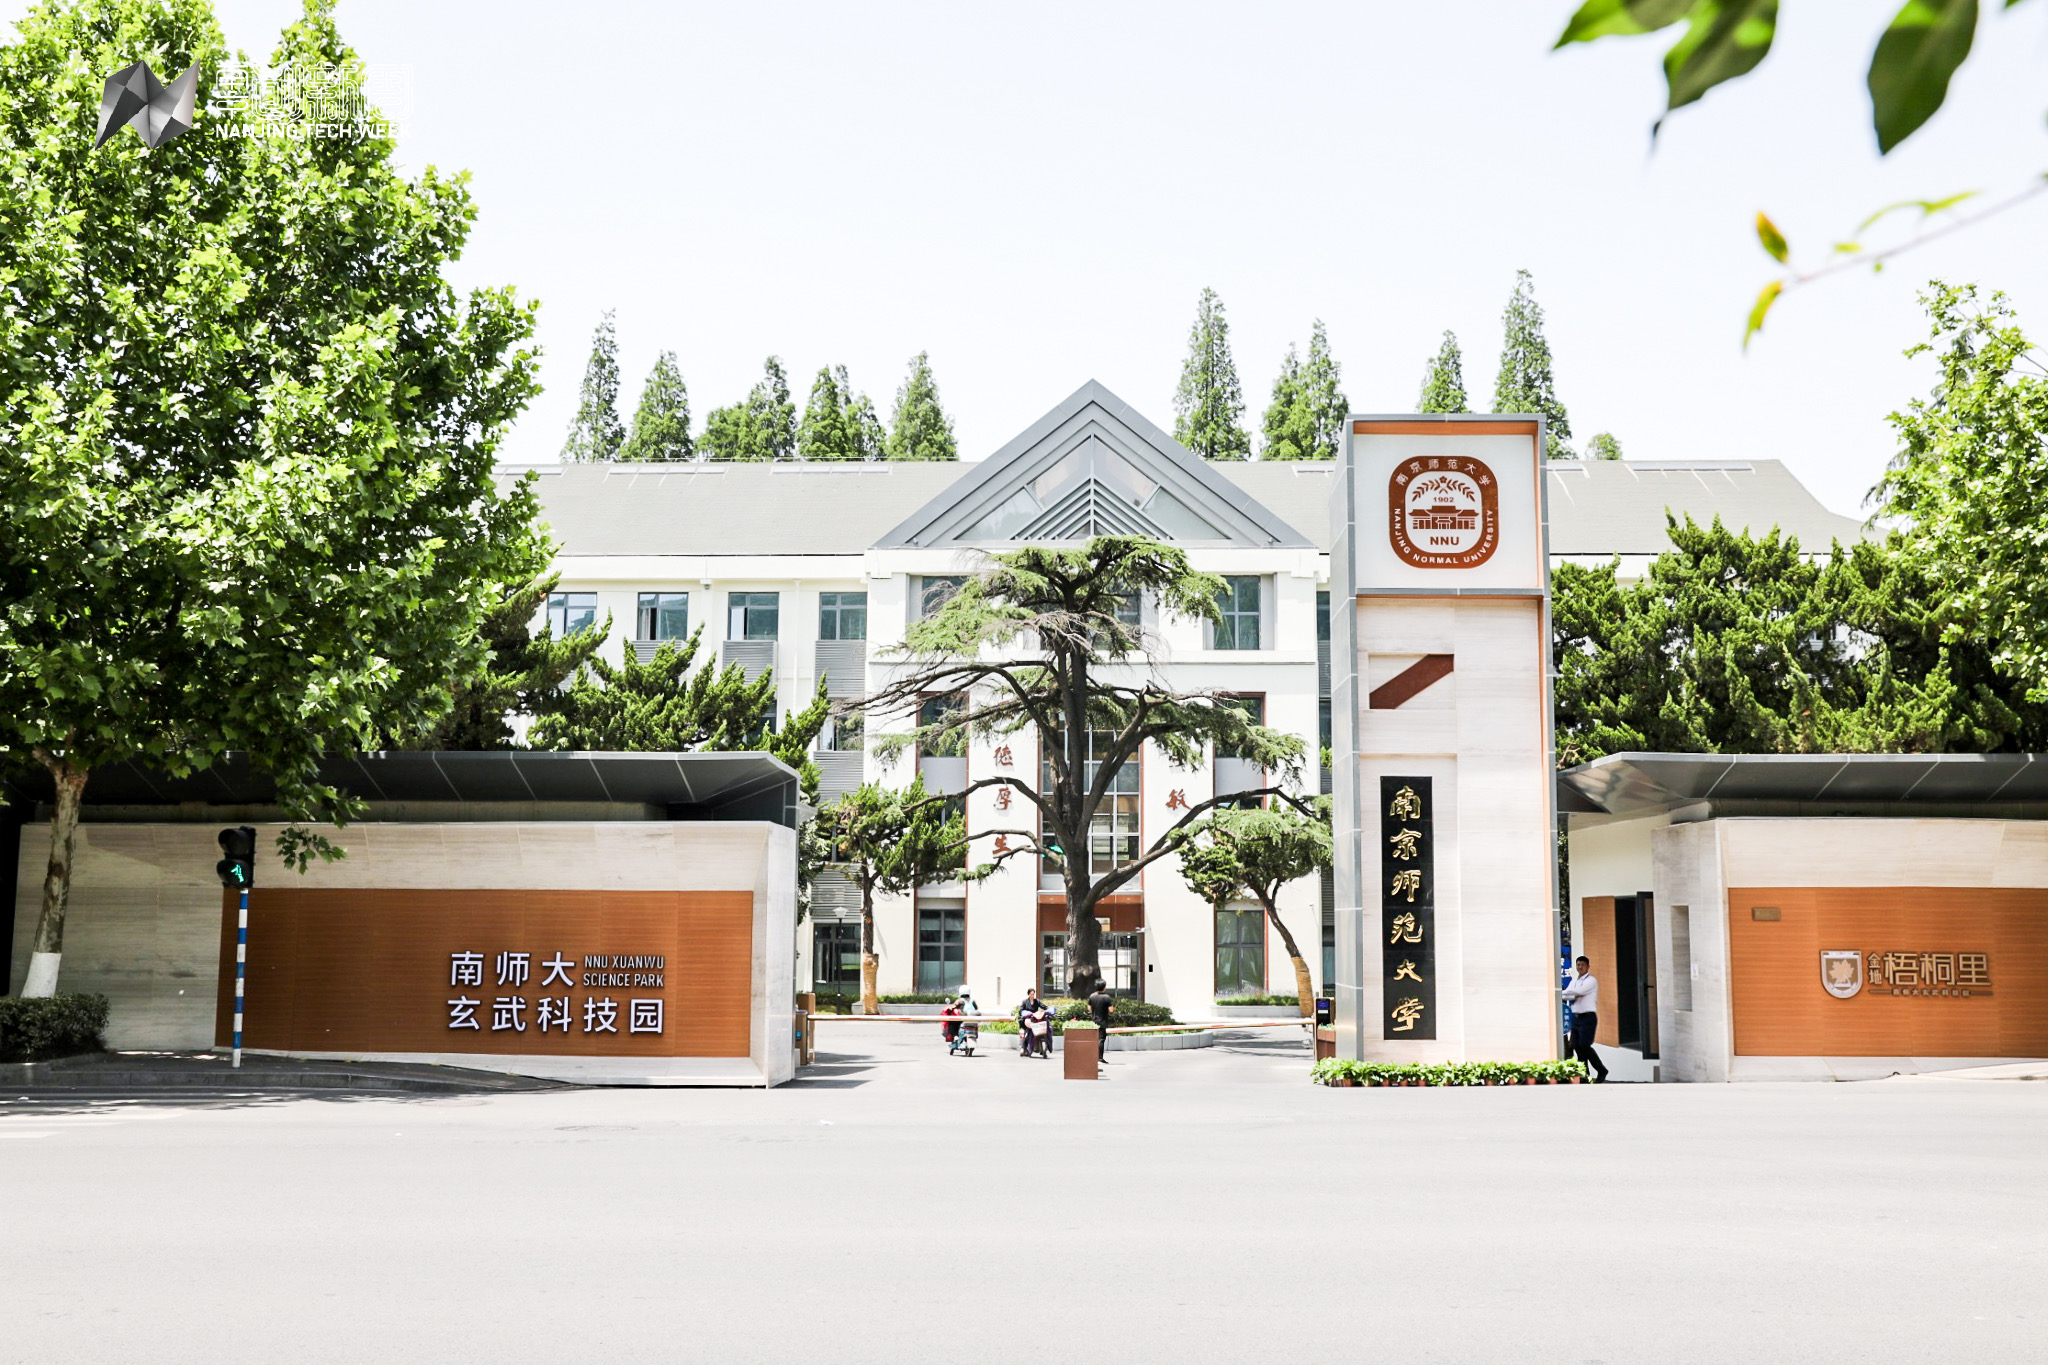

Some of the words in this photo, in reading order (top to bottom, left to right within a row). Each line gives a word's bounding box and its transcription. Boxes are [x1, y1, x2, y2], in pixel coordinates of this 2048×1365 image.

[1394, 508, 1411, 554] NANJING
[1412, 553, 1459, 564] NORMAL
[1463, 509, 1494, 563] UNIVERSITY
[1429, 536, 1460, 546] NNU
[451, 951, 575, 987] 南师大
[584, 954, 609, 969] NNU
[612, 955, 665, 970] XUANWU
[1868, 953, 1882, 985] 金地
[1883, 952, 1991, 985] 梧桐里
[583, 973, 630, 987] SCIENCE
[634, 973, 664, 987] PARK
[447, 995, 664, 1034] 玄武科技园
